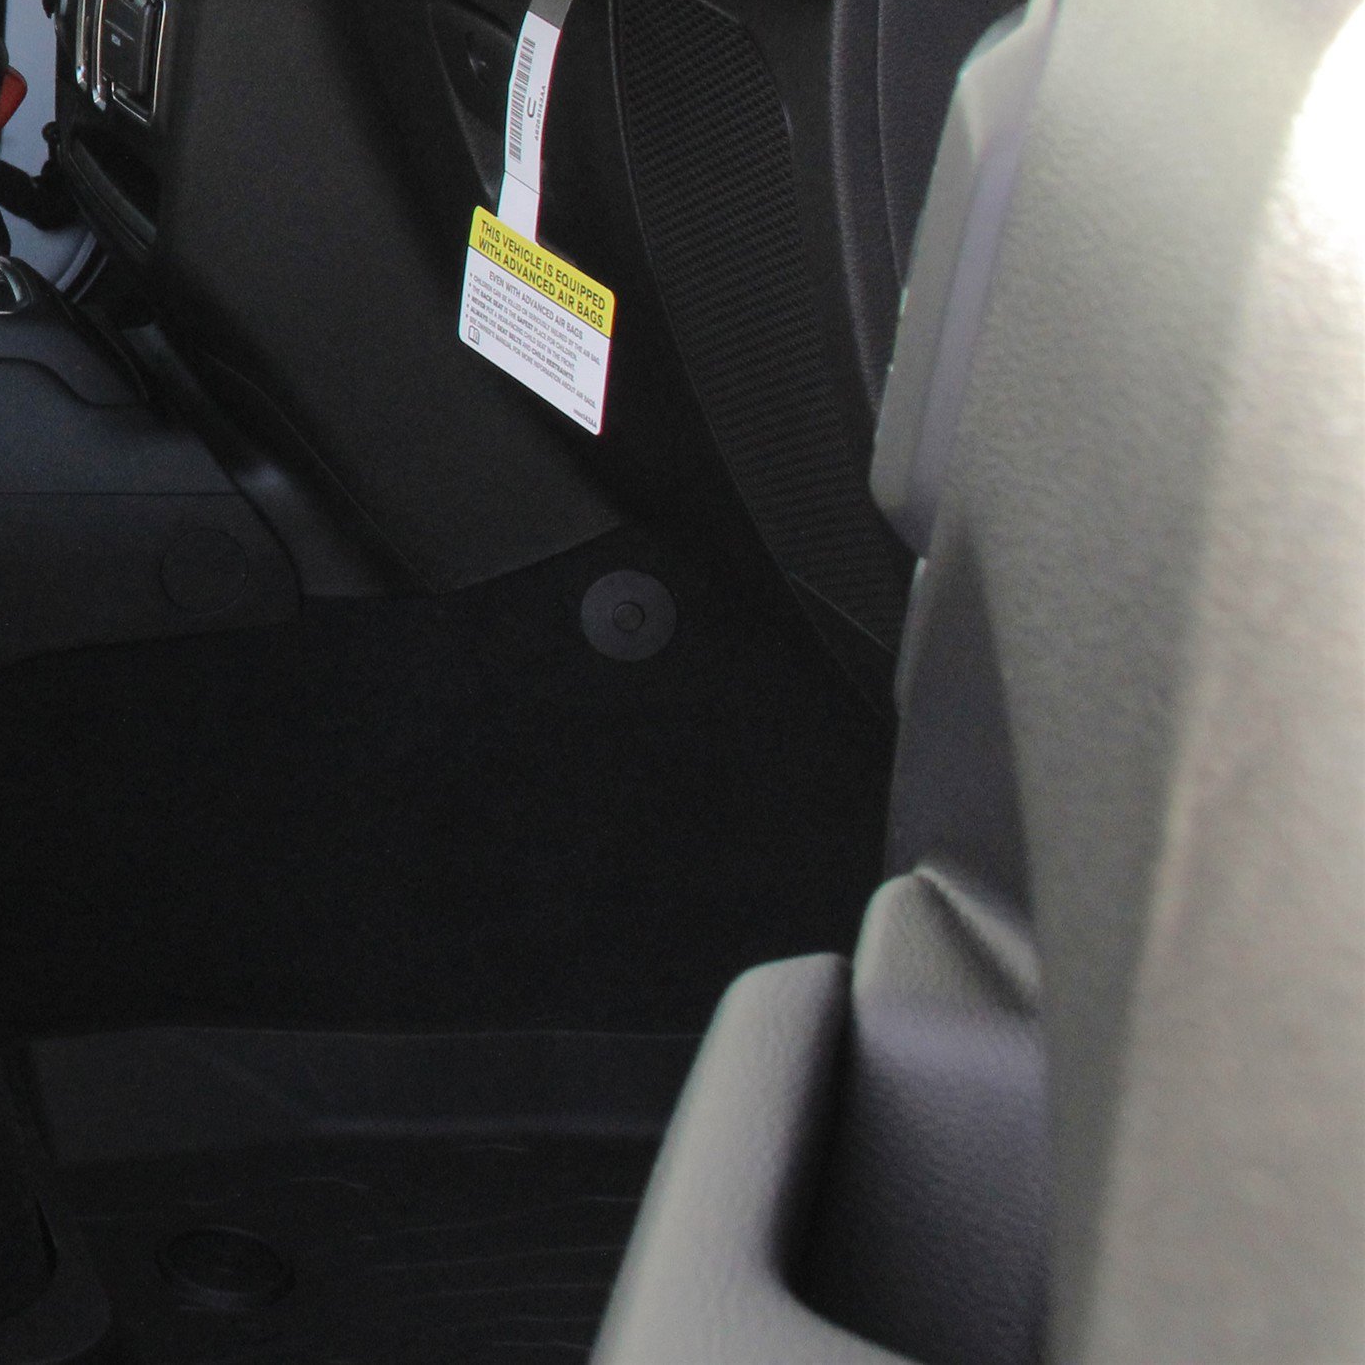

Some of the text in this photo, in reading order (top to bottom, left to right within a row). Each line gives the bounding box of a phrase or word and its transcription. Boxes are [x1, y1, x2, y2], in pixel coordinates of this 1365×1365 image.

[478, 236, 604, 328] WITH ADVANCED AIR BAGS
[480, 220, 606, 312] THIS VEHICLE IS EQUIPPED
[489, 270, 583, 339] EVEN WITH ADVANCED AIR BAGS
